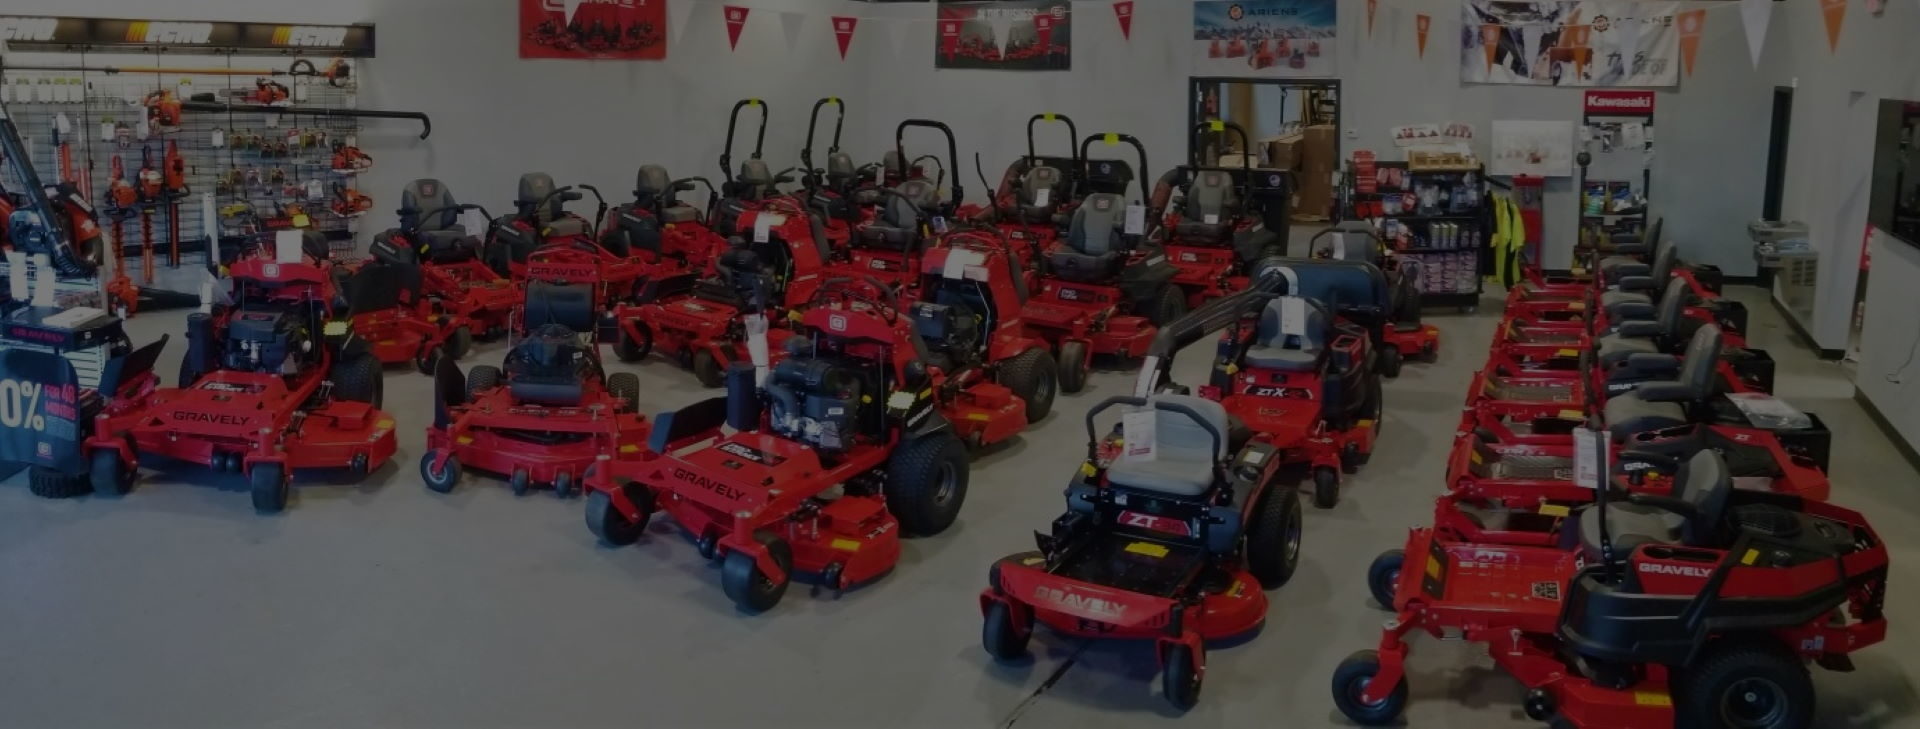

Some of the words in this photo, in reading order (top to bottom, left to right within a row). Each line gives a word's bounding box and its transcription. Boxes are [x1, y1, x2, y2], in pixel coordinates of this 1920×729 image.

[1248, 8, 1299, 16] ARIENS
[1587, 96, 1651, 107] Kawasaki
[532, 267, 592, 277] GRAVELY
[173, 411, 250, 426] GRAVELY
[674, 468, 746, 501] GRAVELY
[1639, 563, 1712, 578] GRAVELY
[1033, 586, 1127, 614] GRAVELY
